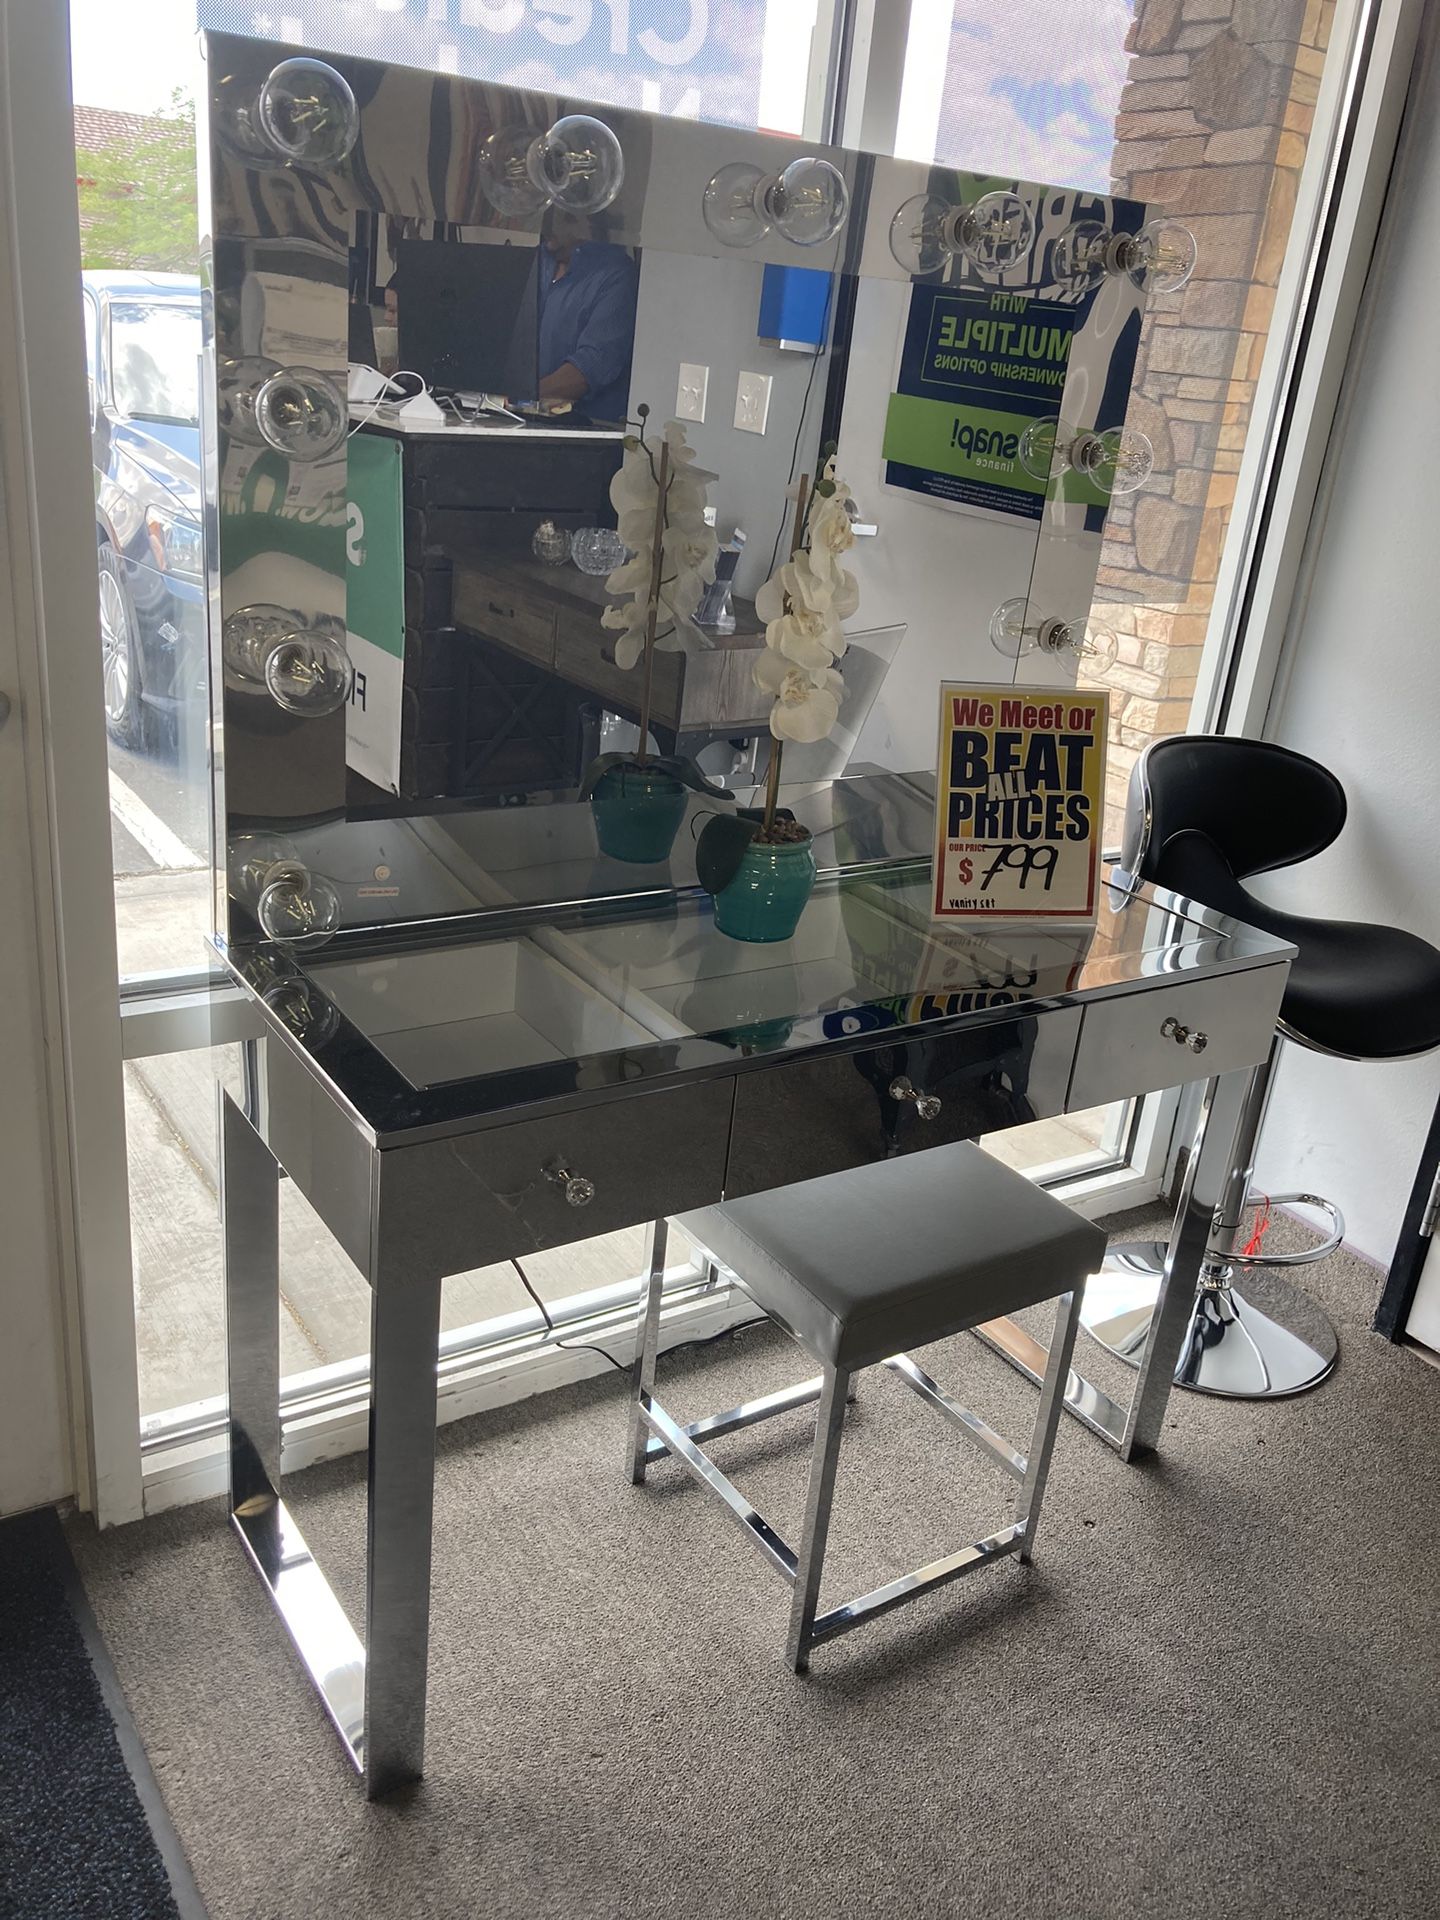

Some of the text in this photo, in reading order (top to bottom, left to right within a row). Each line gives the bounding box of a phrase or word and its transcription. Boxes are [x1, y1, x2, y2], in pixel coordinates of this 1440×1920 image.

[952, 697, 1096, 731] We Meet or
[950, 729, 1094, 791] BEAT
[988, 769, 1031, 801] ALL
[948, 791, 1090, 841] PRICES
[949, 843, 987, 853] OUR PRICE
[980, 843, 1059, 891] 799
[949, 897, 995, 910] vanity set
